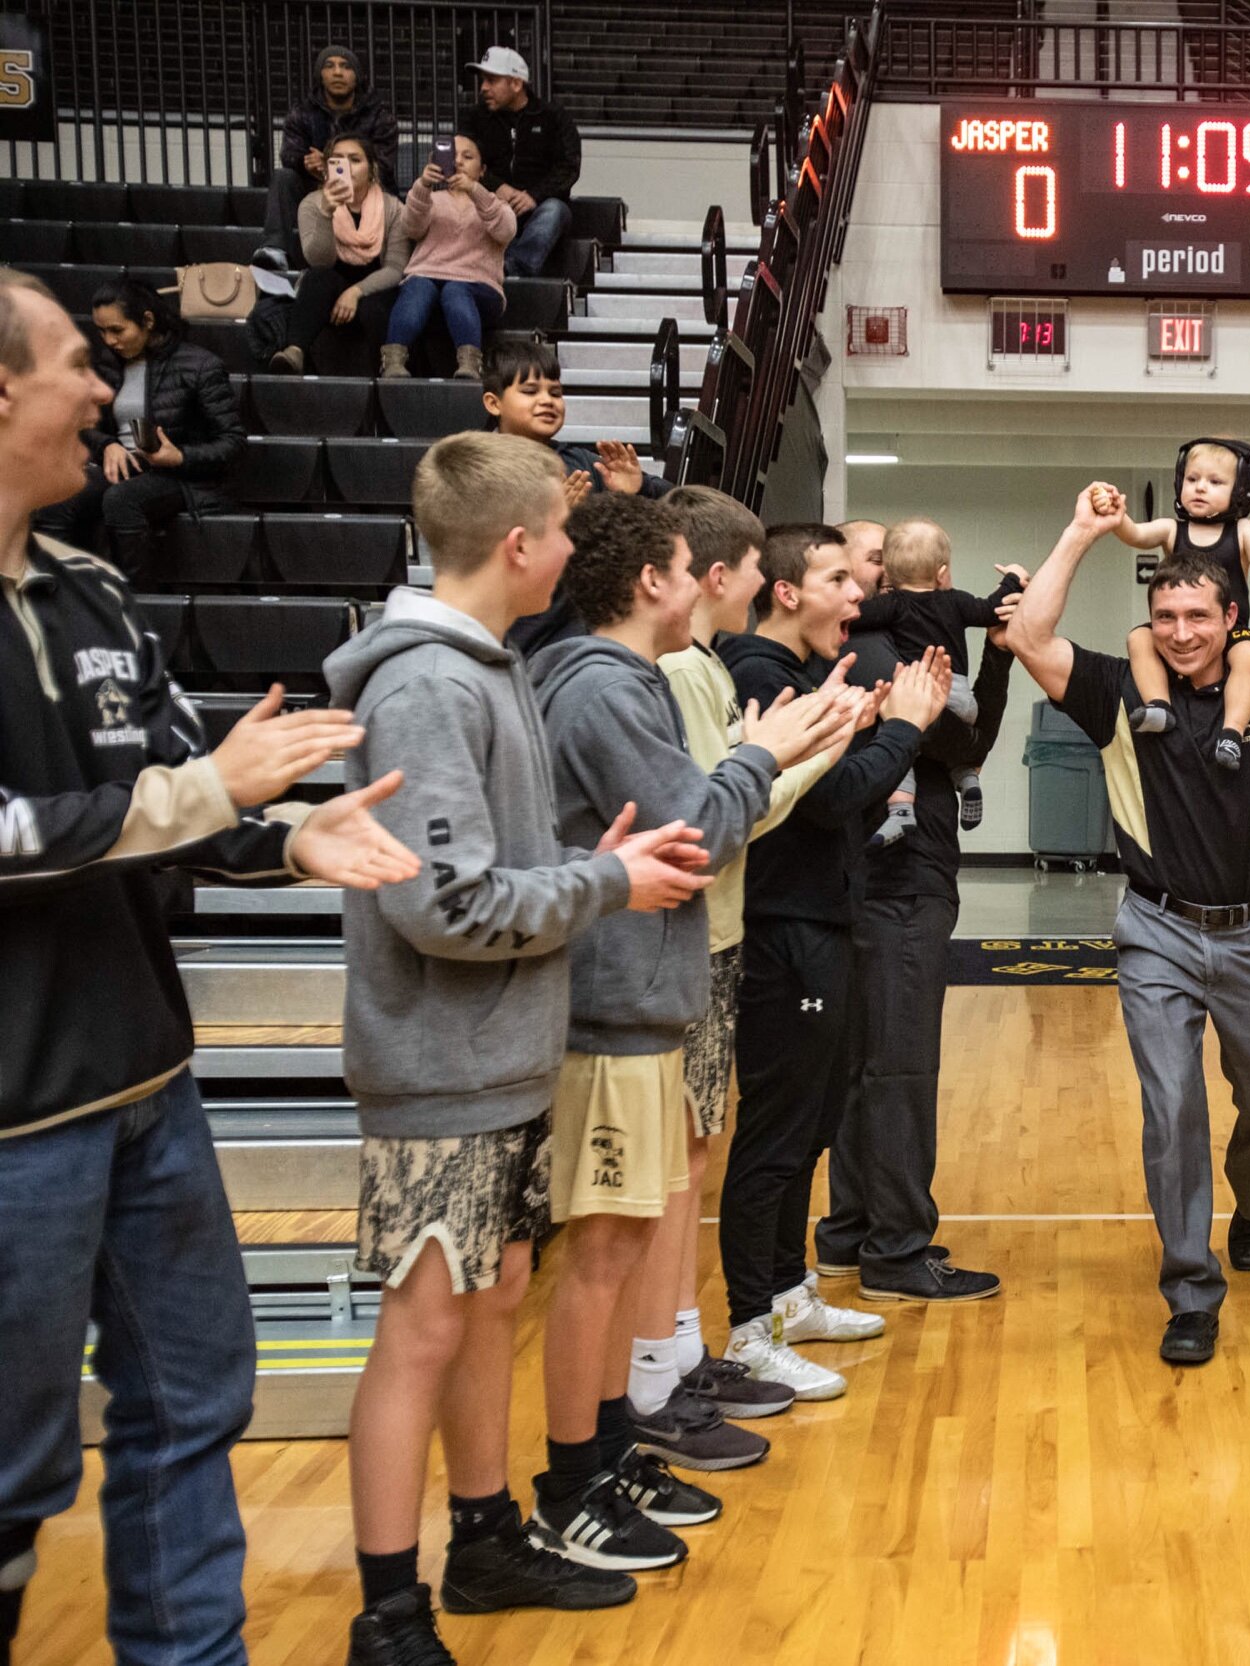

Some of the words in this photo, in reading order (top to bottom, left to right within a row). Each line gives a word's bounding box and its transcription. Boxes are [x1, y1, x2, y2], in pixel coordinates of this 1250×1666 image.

[951, 119, 1048, 152] JASPER
[1015, 165, 1055, 238] 0
[1168, 213, 1207, 223] NEVCO
[1142, 243, 1224, 279] period
[1161, 318, 1204, 351] EXIT
[591, 1169, 623, 1188] JAC
